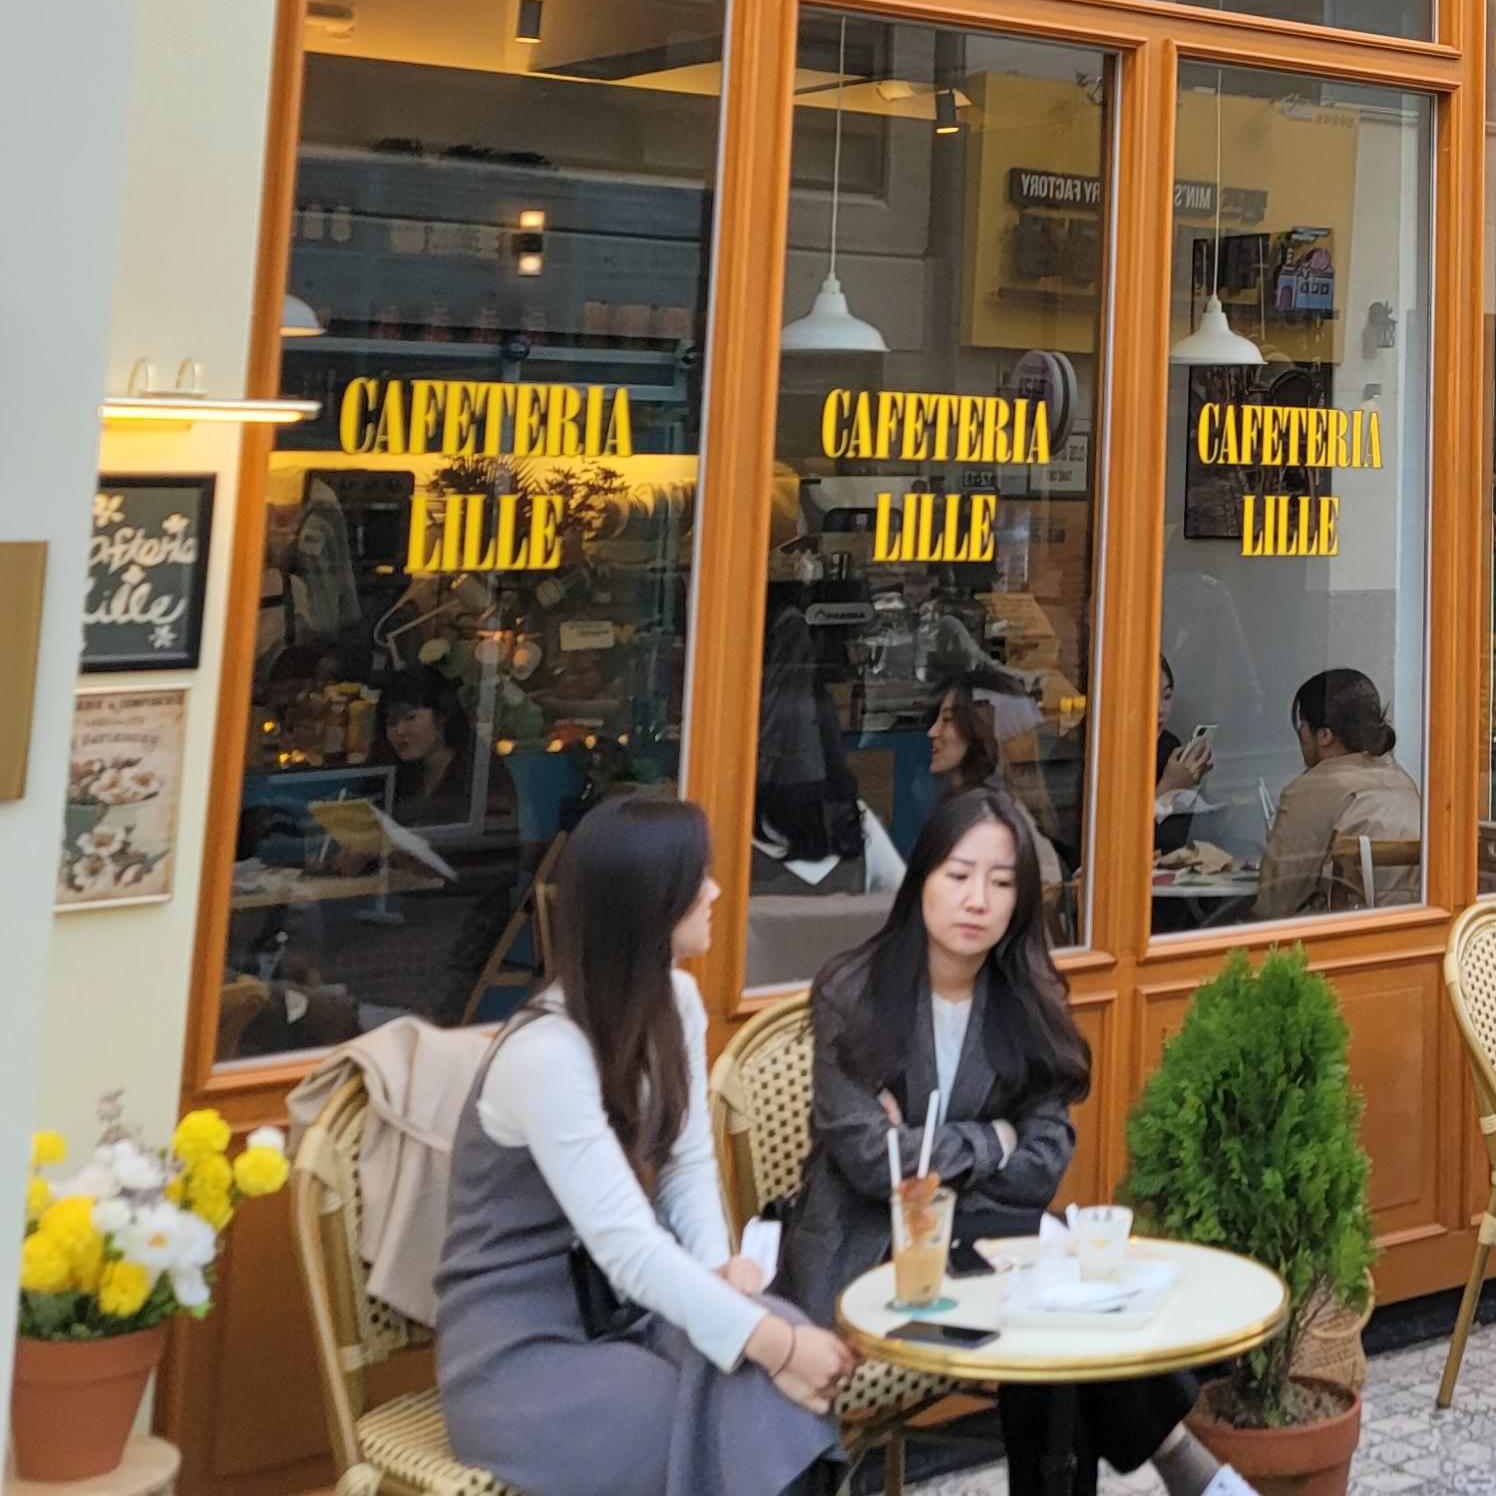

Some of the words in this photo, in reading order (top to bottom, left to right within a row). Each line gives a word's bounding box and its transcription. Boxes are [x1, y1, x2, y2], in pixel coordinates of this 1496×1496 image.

[339, 376, 634, 457] CAFETERIA
[821, 388, 1051, 465] CAFETERIA
[1197, 402, 1383, 469] CAFETERIA
[405, 493, 564, 575] LILLE
[872, 493, 997, 562] LILLE
[1240, 495, 1340, 557] LILLE
